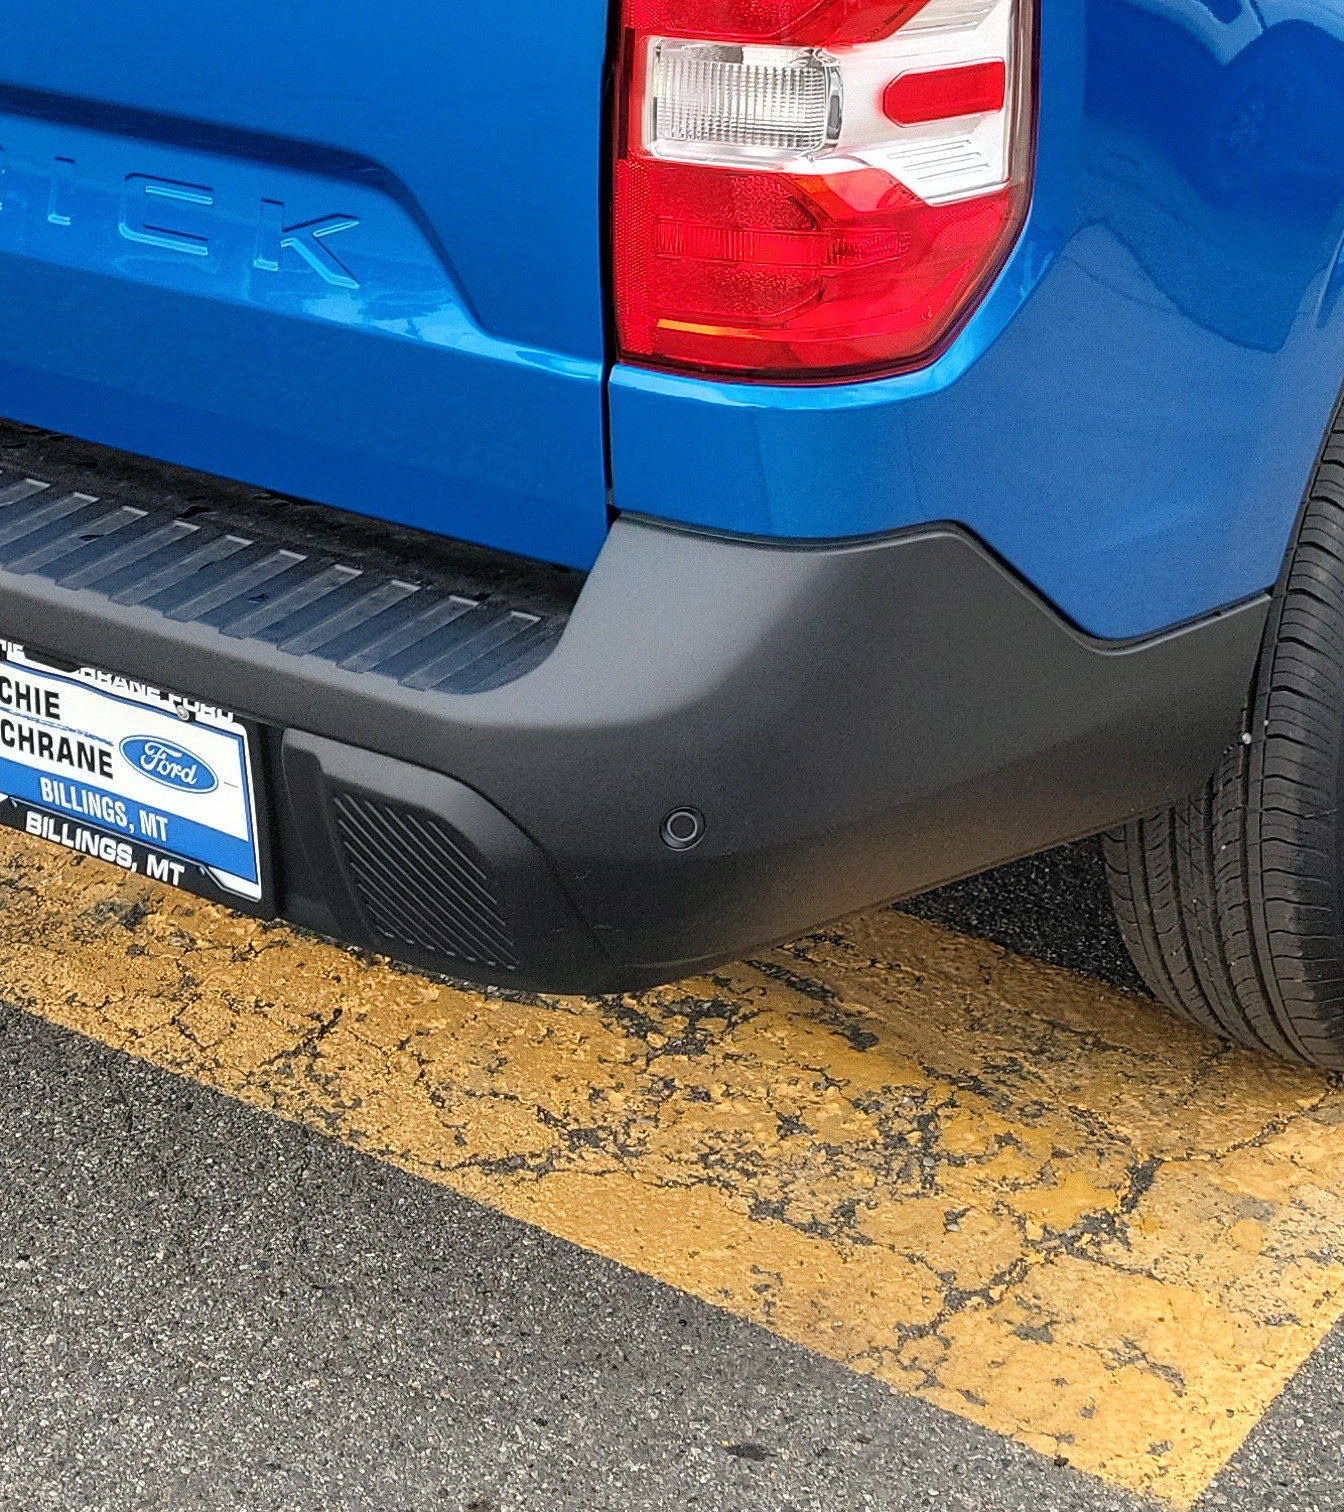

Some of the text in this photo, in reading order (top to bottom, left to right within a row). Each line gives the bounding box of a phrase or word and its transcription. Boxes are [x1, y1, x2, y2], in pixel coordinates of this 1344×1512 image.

[140, 741, 198, 786] Ford
[39, 776, 169, 843] BILLINGS, MT
[25, 810, 186, 887] BILLINGS, MT
